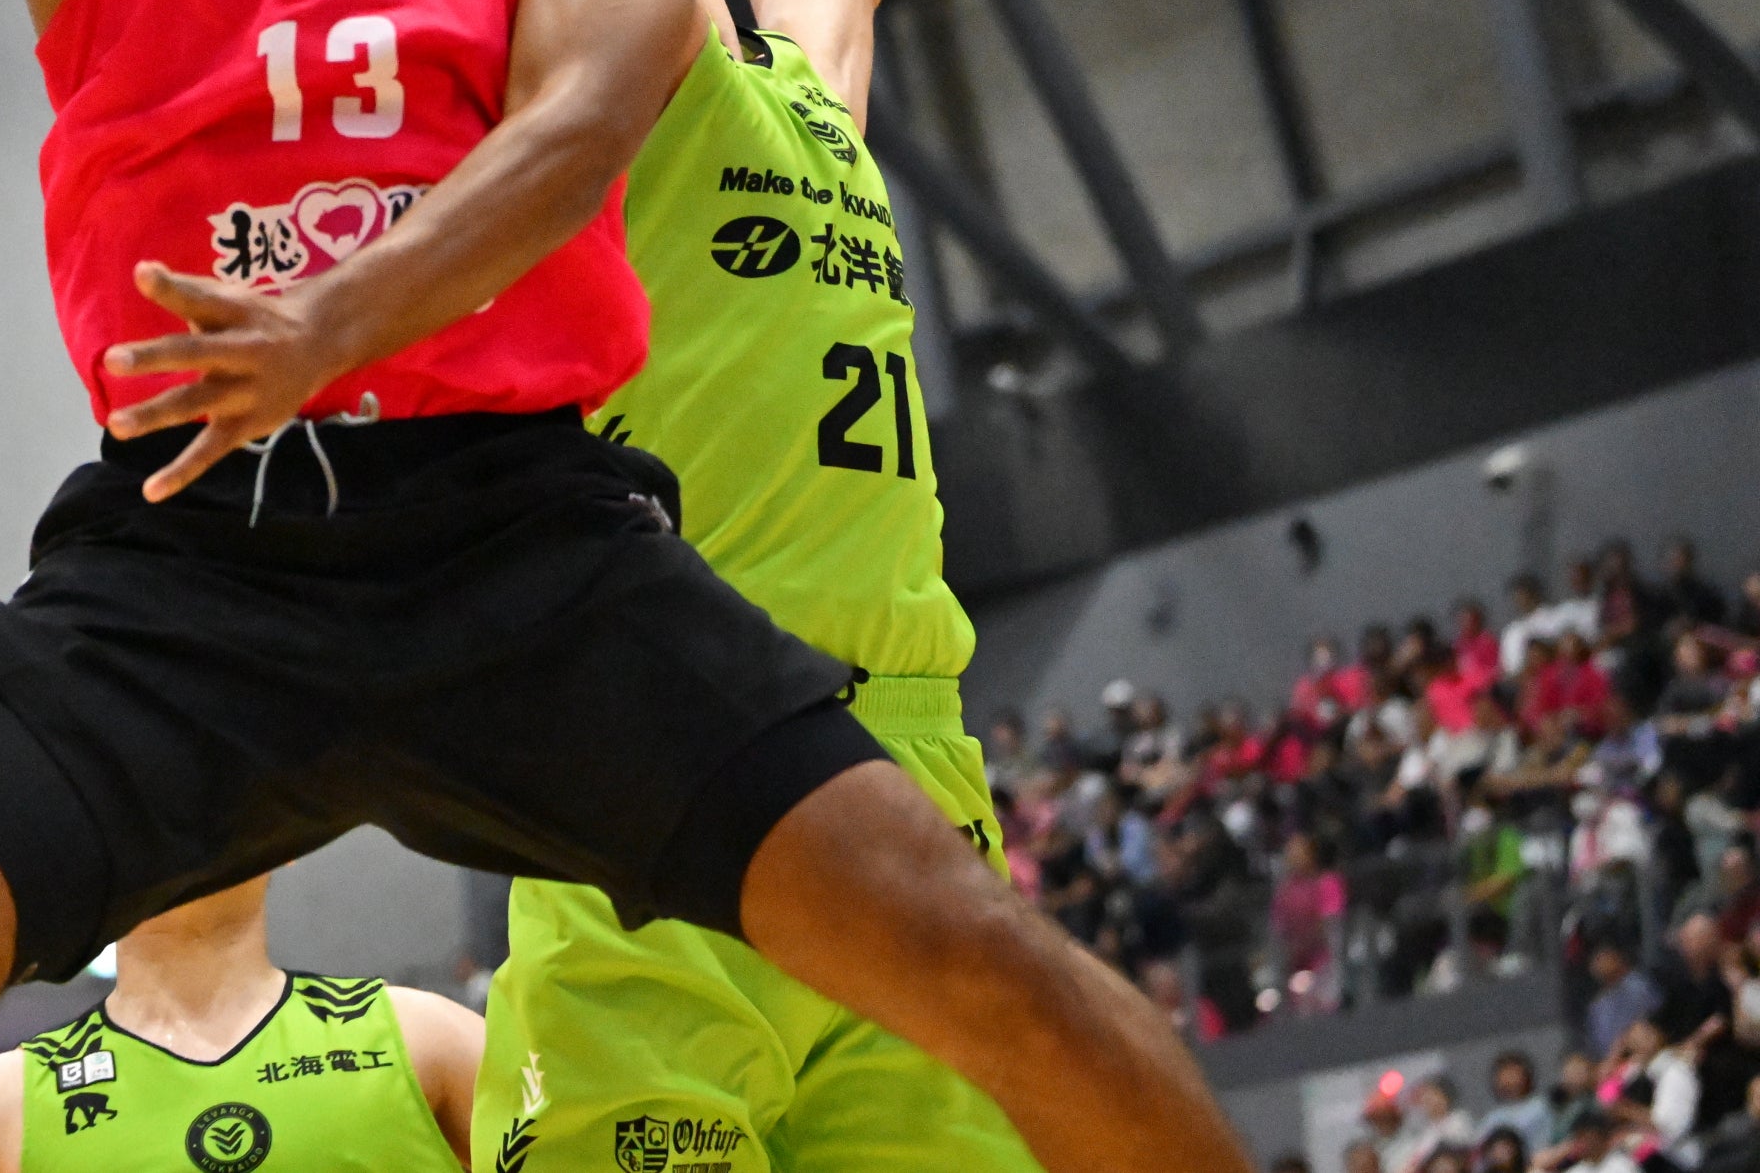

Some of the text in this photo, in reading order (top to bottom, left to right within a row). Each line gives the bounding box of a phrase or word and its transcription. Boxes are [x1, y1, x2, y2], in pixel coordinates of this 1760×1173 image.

[256, 15, 404, 141] 13
[719, 167, 795, 196] Make
[801, 176, 834, 205] the
[817, 341, 917, 481] 21
[256, 1049, 394, 1084] 北海電工
[196, 1105, 255, 1129] LEVANGA
[200, 1147, 264, 1173] HOKKAIDO
